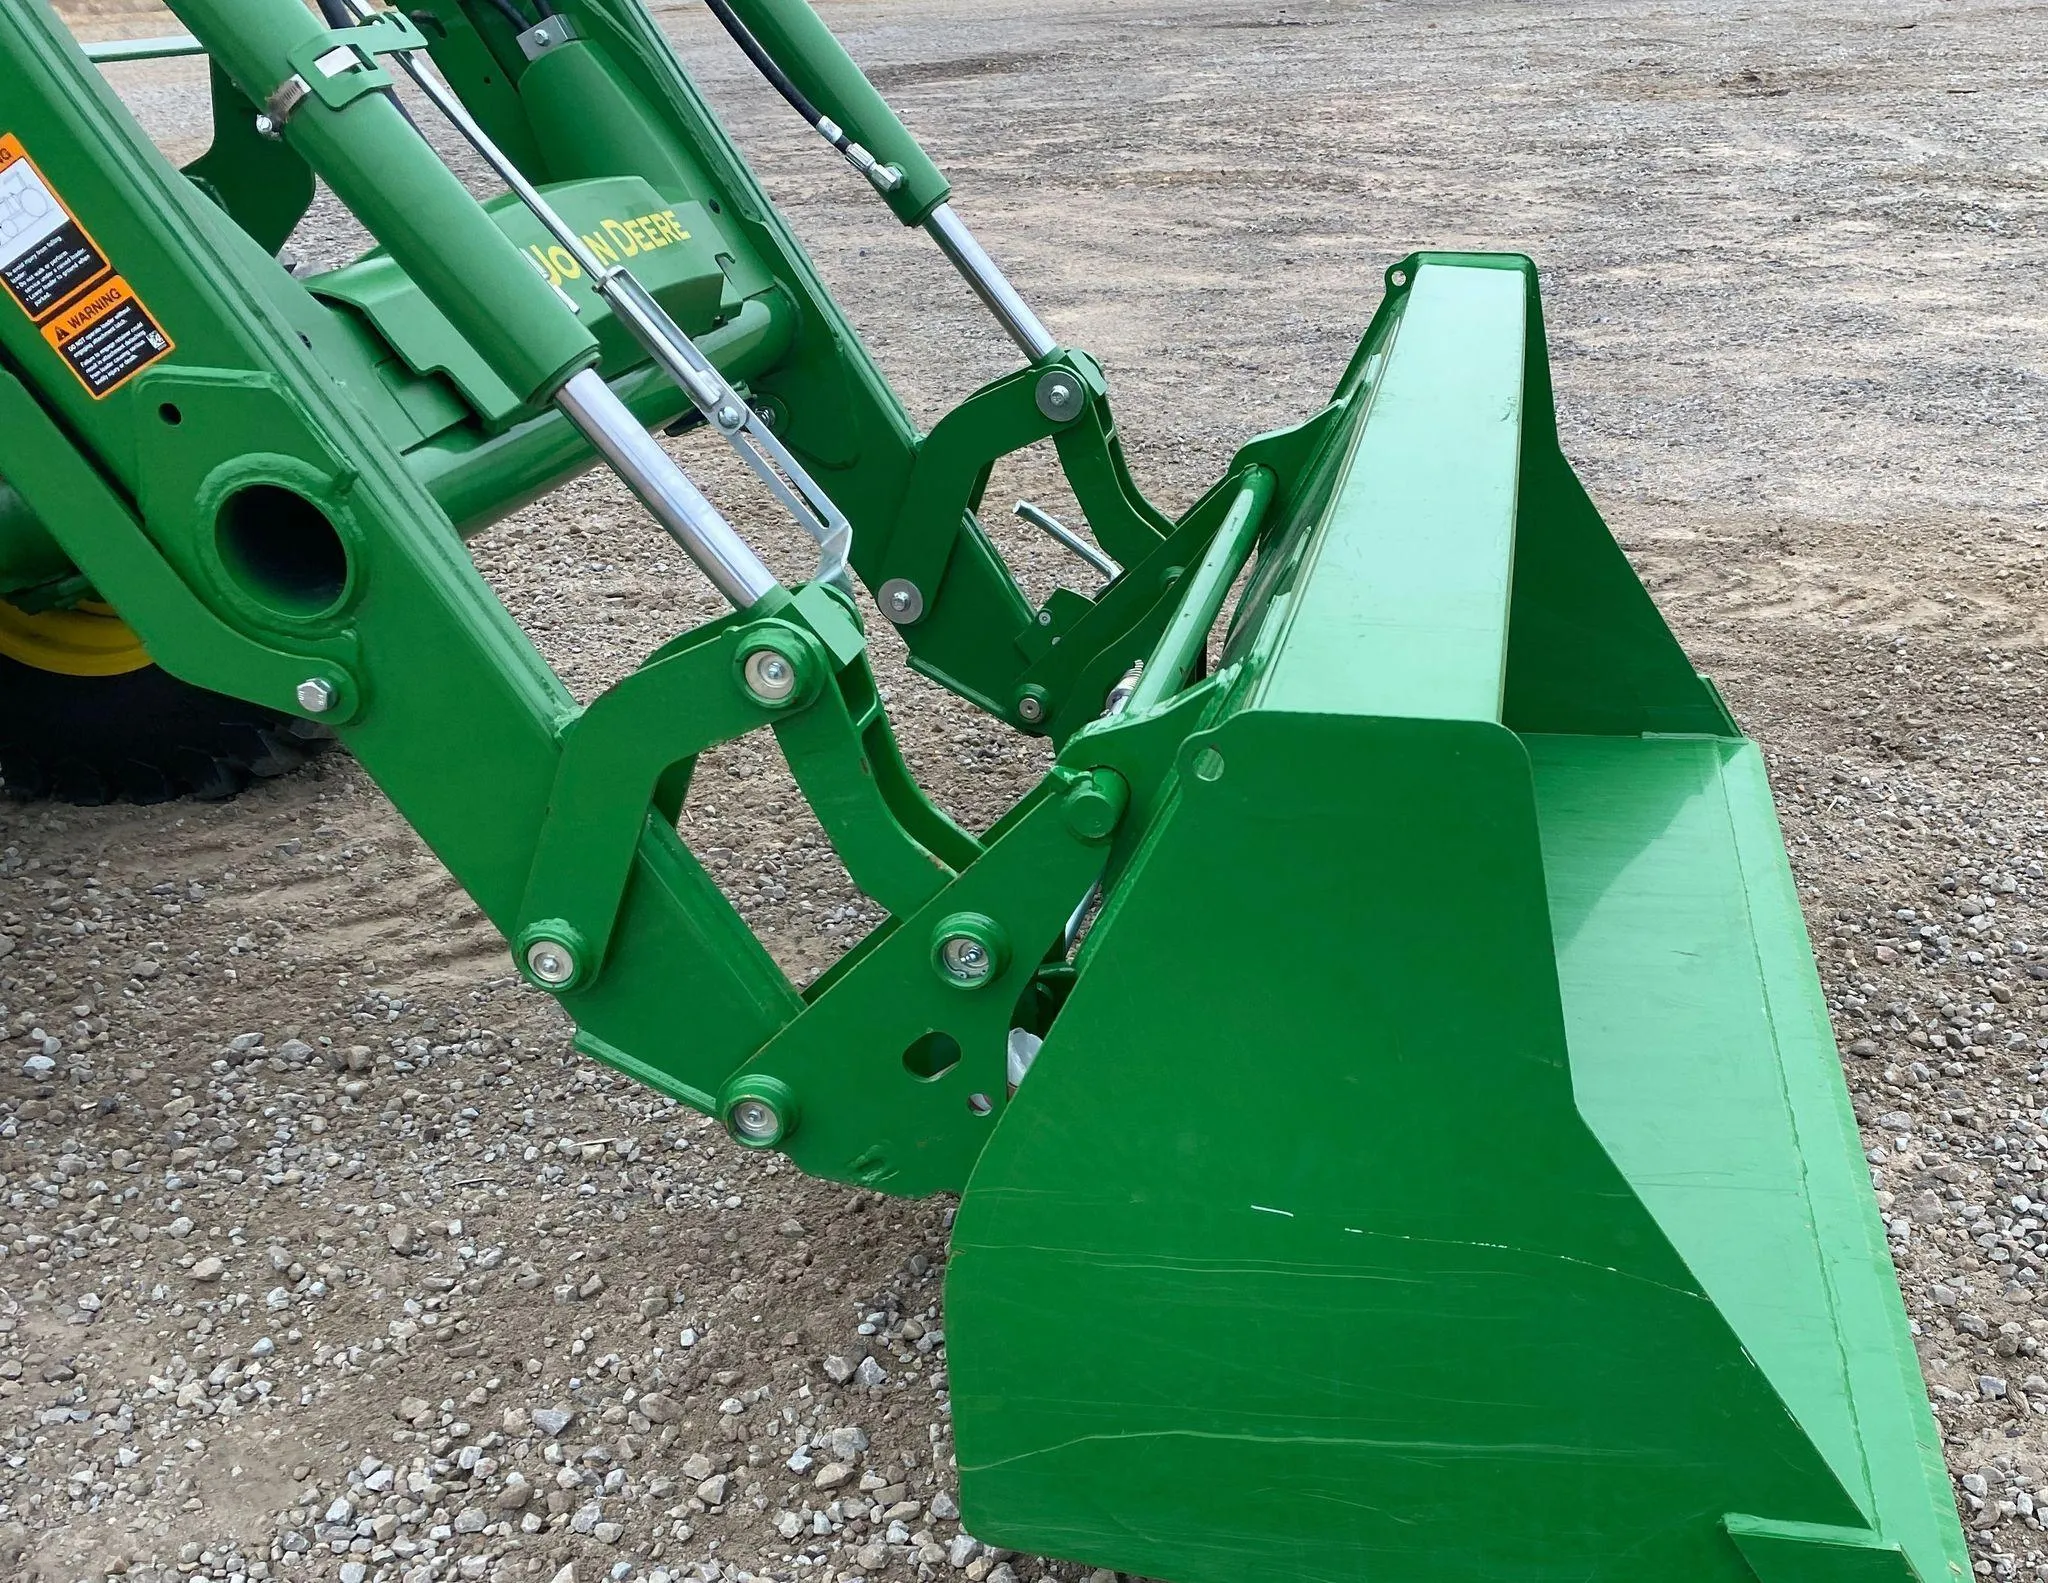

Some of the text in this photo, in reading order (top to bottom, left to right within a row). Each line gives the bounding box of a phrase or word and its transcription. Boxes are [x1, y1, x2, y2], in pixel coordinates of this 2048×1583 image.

[12, 262, 24, 273] avoid
[24, 254, 37, 265] injury
[36, 246, 48, 255] from
[47, 236, 62, 247] falling
[34, 268, 45, 276] walk
[50, 251, 68, 266] perform
[530, 209, 691, 286] JON DEERE
[25, 280, 40, 293] service
[40, 271, 53, 282] under
[57, 258, 71, 270] raised
[28, 288, 43, 299] Lower
[42, 278, 57, 290] loader
[62, 262, 78, 277] ground
[78, 254, 90, 265] when
[67, 288, 121, 329] WARNING
[68, 306, 131, 352] DO NOT operate loader without
[74, 343, 94, 358] engaging
[92, 327, 116, 345] attachment
[80, 356, 95, 367] Failure
[100, 341, 116, 354] engage
[131, 321, 143, 332] could
[86, 363, 98, 373] result
[102, 344, 125, 362] attachment
[124, 330, 147, 346] detaching
[90, 371, 101, 379] from
[100, 361, 113, 372] loader
[113, 350, 131, 363] causing
[129, 340, 146, 352] serious
[94, 375, 109, 385] bodily
[108, 367, 120, 377] injury
